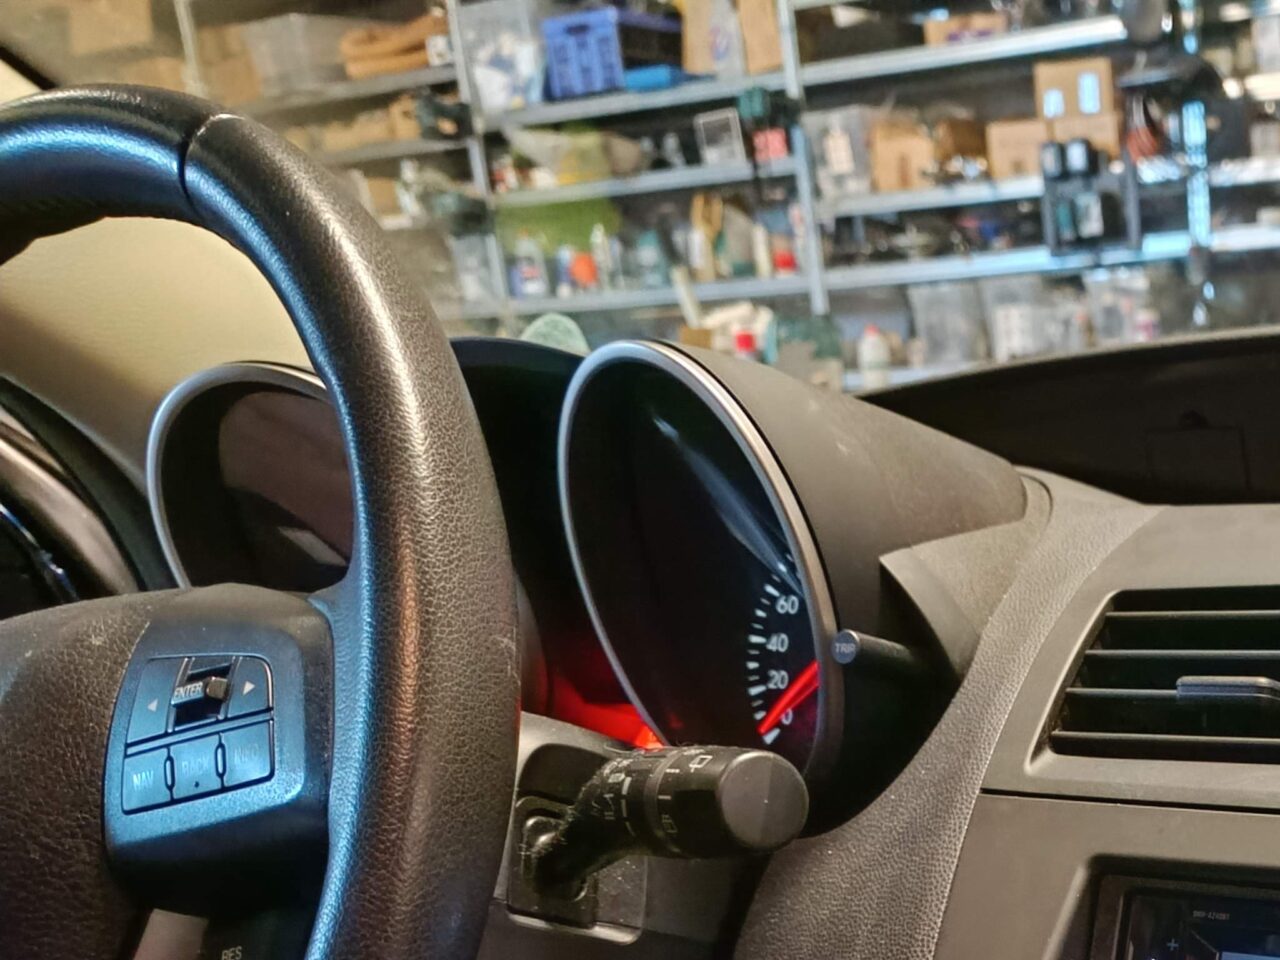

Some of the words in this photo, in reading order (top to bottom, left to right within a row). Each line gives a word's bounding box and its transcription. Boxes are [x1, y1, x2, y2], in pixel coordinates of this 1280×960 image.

[775, 596, 800, 615] 60
[766, 633, 789, 652] 40
[834, 642, 857, 655] TRIP
[767, 670, 789, 689] 20
[173, 681, 204, 700] ENTER
[132, 770, 155, 791] NAV
